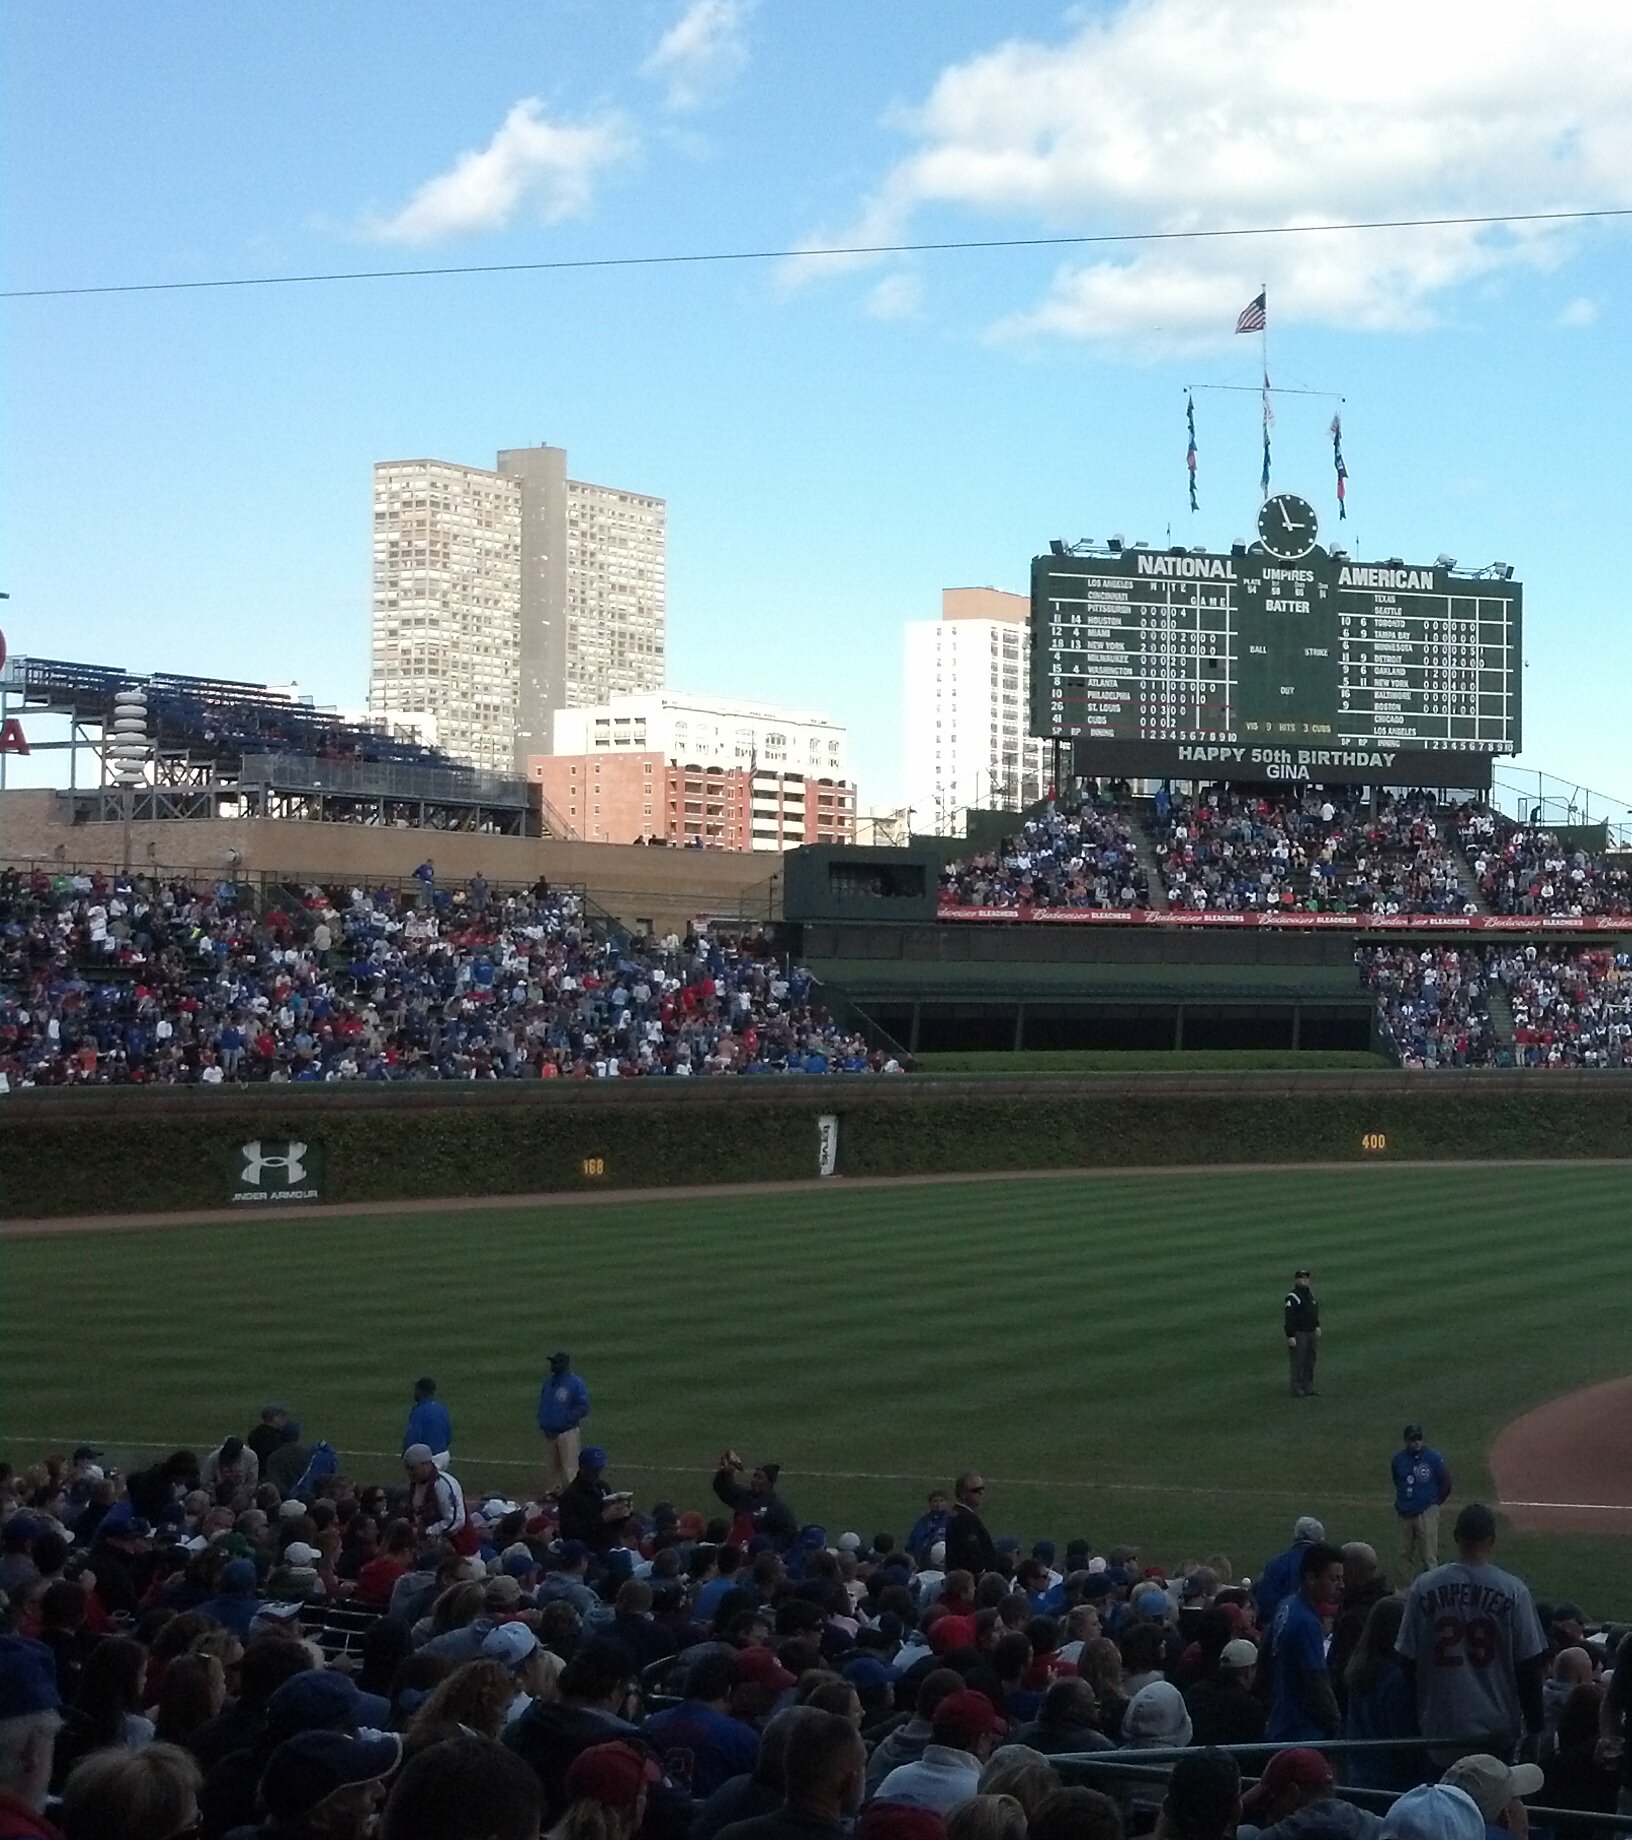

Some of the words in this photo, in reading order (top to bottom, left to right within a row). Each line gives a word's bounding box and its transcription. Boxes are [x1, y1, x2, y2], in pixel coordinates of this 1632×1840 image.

[1138, 555, 1237, 579] NATIONAL
[1263, 568, 1314, 582] UMPIRES
[1338, 567, 1434, 590] AMERICAN
[1088, 579, 1101, 587] LOS
[1102, 580, 1133, 589] ANGELES
[1374, 594, 1396, 603] TEXAS
[1088, 604, 1131, 614] PITTSBURGH
[1266, 599, 1310, 613] BATTER
[1374, 606, 1402, 616] SEATTLE
[1071, 614, 1082, 624] 14
[1088, 616, 1122, 625] HOUSTON
[1341, 617, 1351, 626] 10
[1360, 618, 1367, 626] 6
[1374, 619, 1405, 628] TORONTO
[1052, 627, 1062, 636] 12
[1073, 628, 1080, 637] 4
[1088, 629, 1110, 637] MIAMI
[1343, 629, 1350, 637] 6
[1374, 630, 1396, 639] TAMPA
[1071, 640, 1081, 649] 13
[1088, 641, 1104, 650] NEW
[1105, 642, 1125, 651] YORK
[1249, 645, 1267, 654] BALL
[1054, 652, 1061, 661] 4
[1088, 654, 1129, 664] MILWAUKEE
[1305, 648, 1328, 657] STRIKE
[1374, 654, 1402, 663] DETROIT
[1052, 664, 1062, 673] 15
[1073, 665, 1080, 674] 4
[1088, 666, 1133, 675] WASHINGTON
[1374, 667, 1406, 676] OAKLAND
[1054, 677, 1061, 686] 8
[1088, 679, 1118, 687] ATLANTA
[1391, 680, 1409, 688] YORK
[1052, 689, 1063, 698] 10
[1088, 691, 1131, 700] PHILADELPHIA
[1280, 687, 1295, 695] OUT
[1341, 689, 1350, 698] 16
[1051, 701, 1064, 710] 26
[1088, 703, 1098, 712] ST.
[1099, 704, 1121, 712] LOUIS
[1140, 705, 1146, 714] 0
[1150, 705, 1156, 714] 0
[1161, 706, 1166, 715] 3
[1171, 706, 1176, 715] 0
[1180, 706, 1186, 715] 0
[1343, 701, 1349, 710] 9
[1374, 702, 1401, 711] BOSTON
[1052, 714, 1062, 723] 41
[1088, 716, 1107, 724] CUBS
[1140, 717, 1146, 726] 0
[1150, 717, 1156, 727] 0
[1160, 718, 1166, 727] 0
[1171, 718, 1176, 727] 2
[1374, 715, 1404, 724] CHICAGO
[1279, 723, 1296, 732] HITS
[1303, 723, 1309, 733] 3
[1312, 724, 1331, 733] CUBS
[1374, 727, 1386, 735] LOS
[1387, 727, 1417, 736] ANGELES
[1150, 730, 1156, 739] 2
[1160, 730, 1166, 739] 3
[1170, 730, 1176, 740] 4
[1180, 731, 1186, 740] 5
[1190, 731, 1196, 740] 6
[1200, 731, 1206, 741] 7
[1210, 732, 1216, 741] 8
[1219, 732, 1225, 742] 9
[1228, 733, 1237, 742] 10
[1433, 741, 1439, 750] 2
[1442, 741, 1448, 750] 3
[1451, 742, 1457, 750] 4
[1460, 742, 1466, 750] 5
[1469, 742, 1475, 751] 6
[1479, 742, 1485, 751] 7
[1488, 743, 1494, 752] 8
[1497, 743, 1503, 752] 9
[1505, 743, 1514, 752] 10
[1179, 746, 1245, 762] HAPPY
[1251, 749, 1291, 764] 50th
[1298, 750, 1396, 767] BIRTHDAY
[1266, 764, 1310, 779] GINA
[937, 908, 976, 917] dweiser
[1030, 908, 1089, 920] Budweiser
[1144, 911, 1202, 922] Budweiser
[1257, 913, 1317, 925] Budweiser
[1369, 915, 1428, 926] Budwiser
[1482, 916, 1541, 927] Budweiser
[1361, 1134, 1385, 1149] 400
[270, 1190, 318, 1200] ARMOUR
[1419, 1583, 1515, 1616] CARPENTER
[1434, 1616, 1501, 1667] 29
